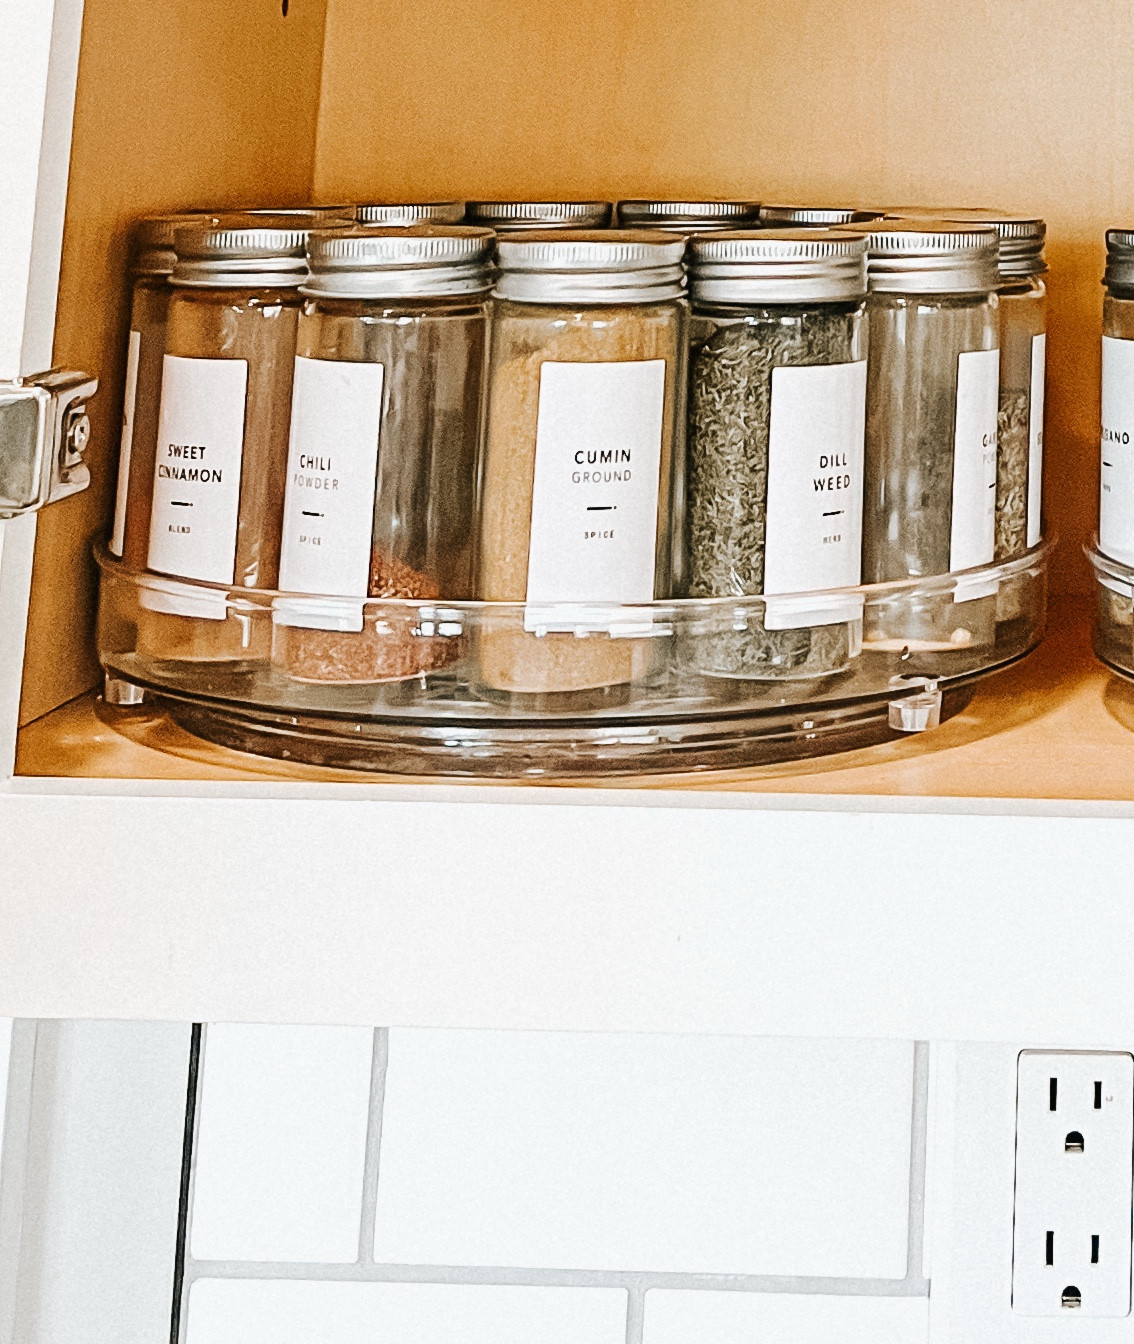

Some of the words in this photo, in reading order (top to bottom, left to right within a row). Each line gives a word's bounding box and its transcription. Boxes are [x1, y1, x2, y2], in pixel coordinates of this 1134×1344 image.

[1102, 428, 1130, 445] GANO
[168, 444, 206, 460] SWEET
[574, 448, 632, 466] CUMIN
[819, 451, 848, 470] DILL
[300, 454, 331, 471] CHILI
[158, 465, 223, 483] CINNAMON
[294, 473, 339, 490] POWDER
[571, 468, 632, 485] GROUND
[813, 474, 852, 492] WEED
[584, 530, 615, 540] SPICE
